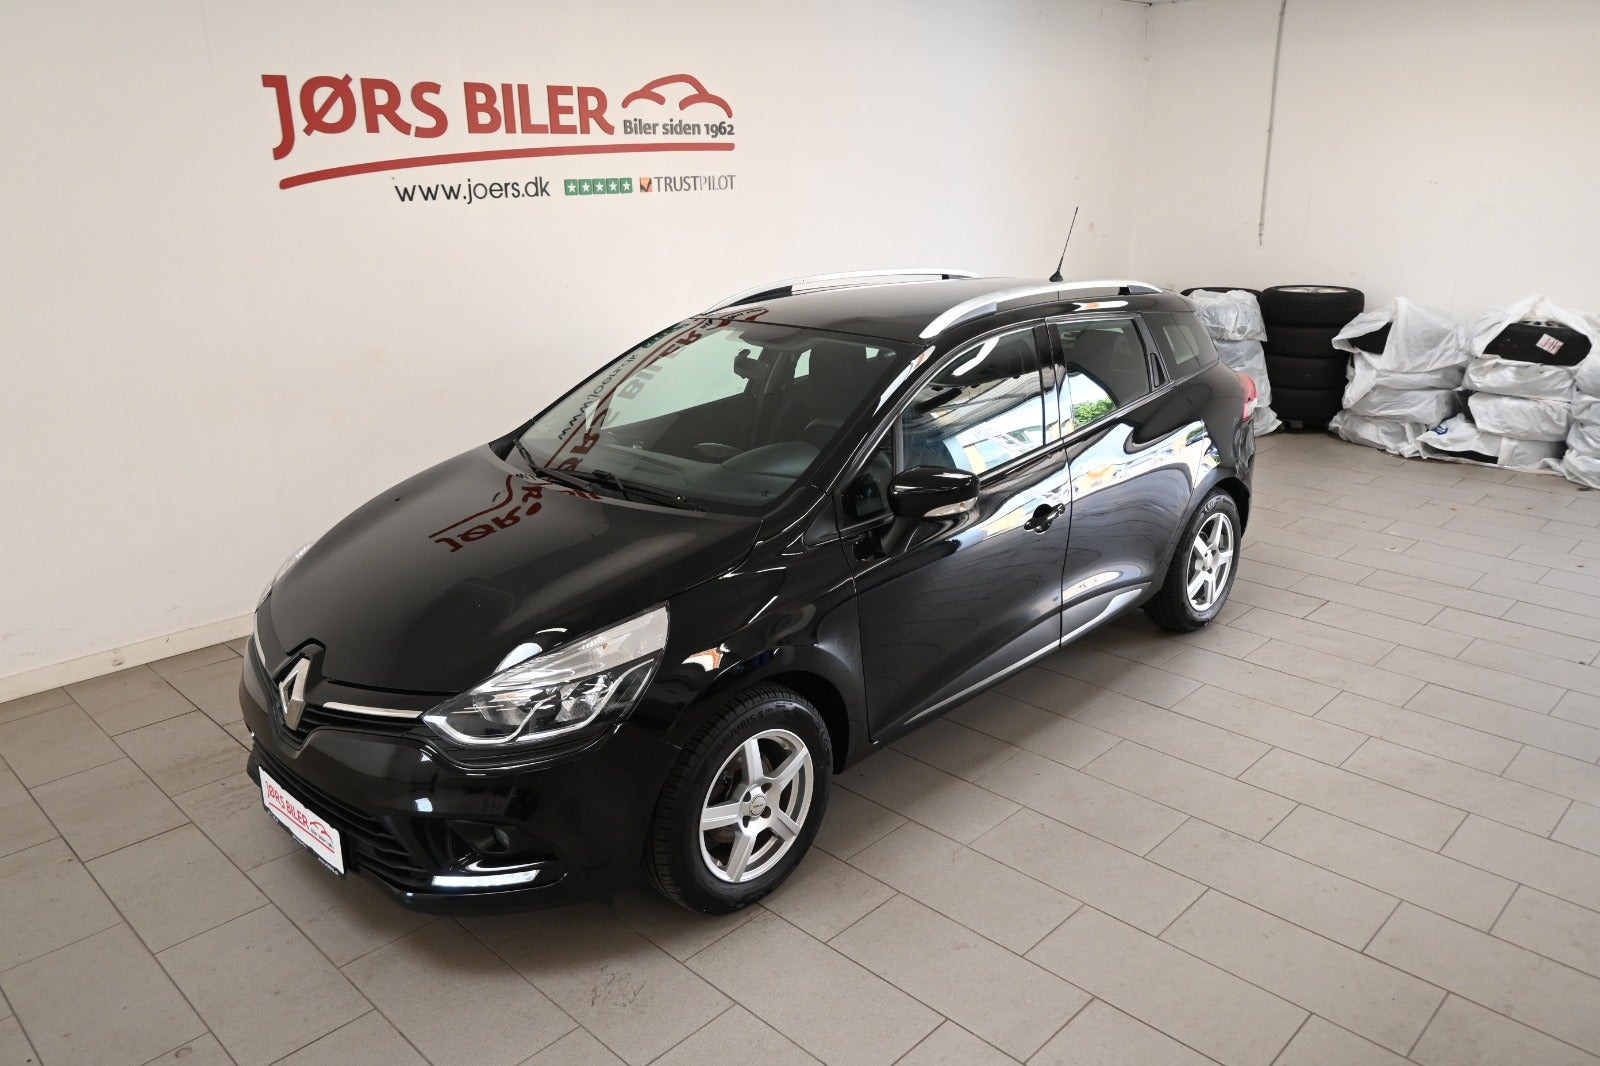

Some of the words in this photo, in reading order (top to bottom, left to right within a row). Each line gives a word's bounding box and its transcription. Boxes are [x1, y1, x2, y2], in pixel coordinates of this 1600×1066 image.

[261, 74, 448, 160] JØRS
[463, 81, 615, 136] BILER
[624, 118, 659, 135] Biler
[662, 118, 701, 135] siden
[704, 121, 735, 138] 1962
[395, 176, 551, 205] www.joers.dk
[654, 175, 736, 192] TRUSTPILOT
